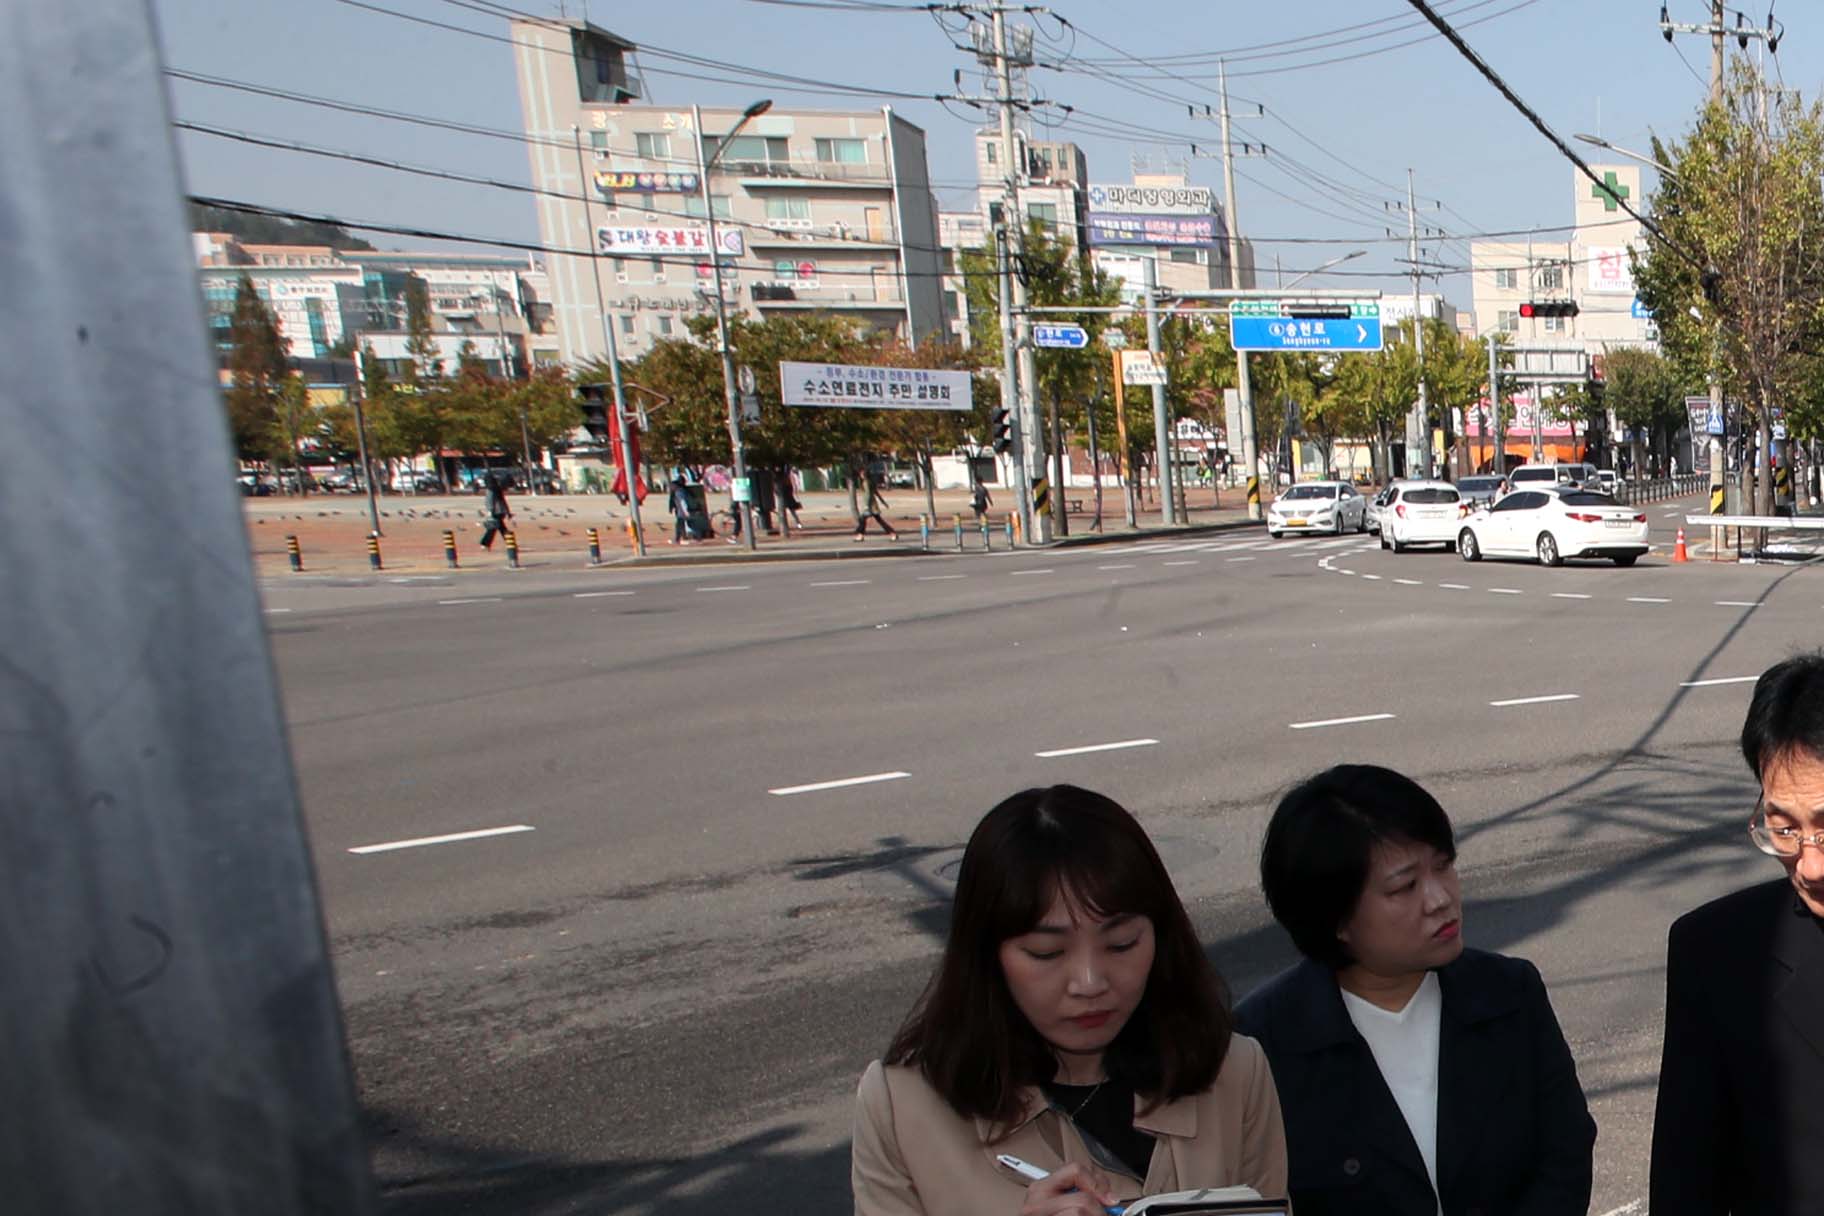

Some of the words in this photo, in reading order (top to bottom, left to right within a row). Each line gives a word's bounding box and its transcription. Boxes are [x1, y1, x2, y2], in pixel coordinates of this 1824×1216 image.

[1286, 322, 1326, 337] 송현로
[803, 379, 884, 398] 수소연료전지
[888, 383, 912, 399] 주민
[917, 384, 951, 400] 설명회
